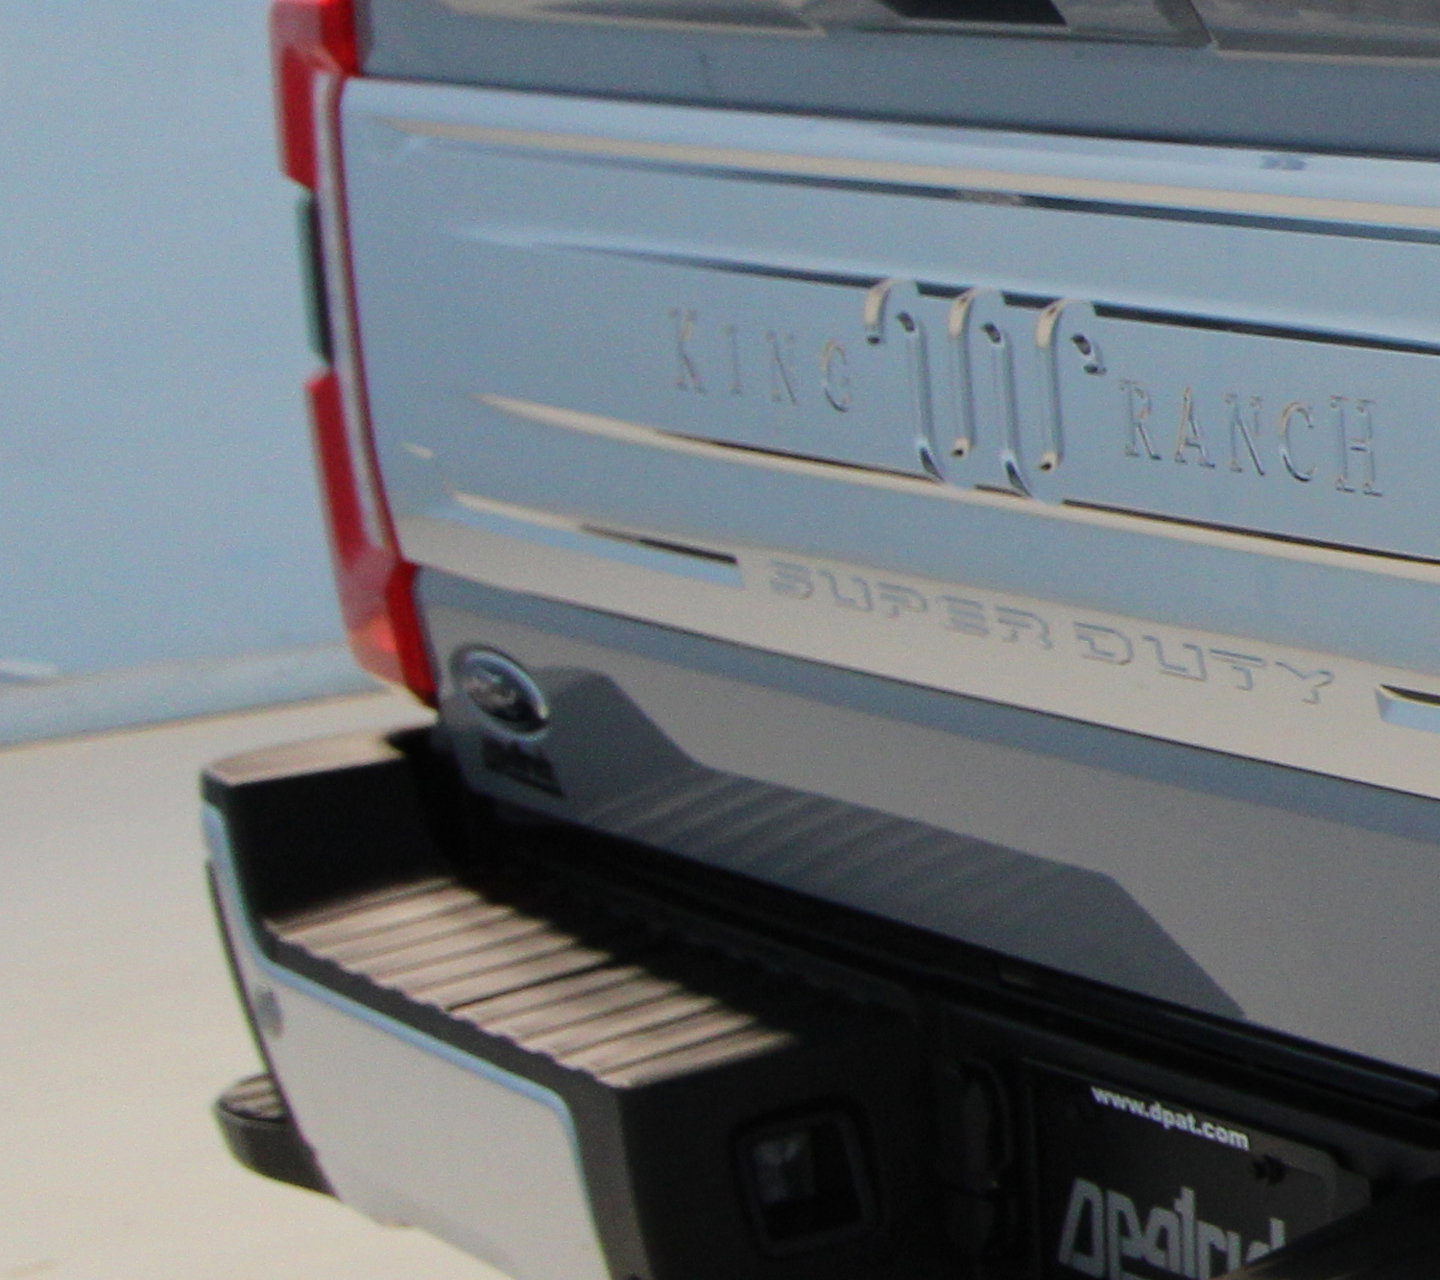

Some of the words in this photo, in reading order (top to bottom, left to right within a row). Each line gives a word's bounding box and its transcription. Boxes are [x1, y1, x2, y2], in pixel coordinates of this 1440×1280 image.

[668, 307, 852, 413] KING
[1118, 377, 1385, 498] RANCH
[770, 558, 1053, 652] SUPER
[1072, 620, 1337, 705] DUTY
[1090, 1085, 1250, 1151] www.dpat.com
